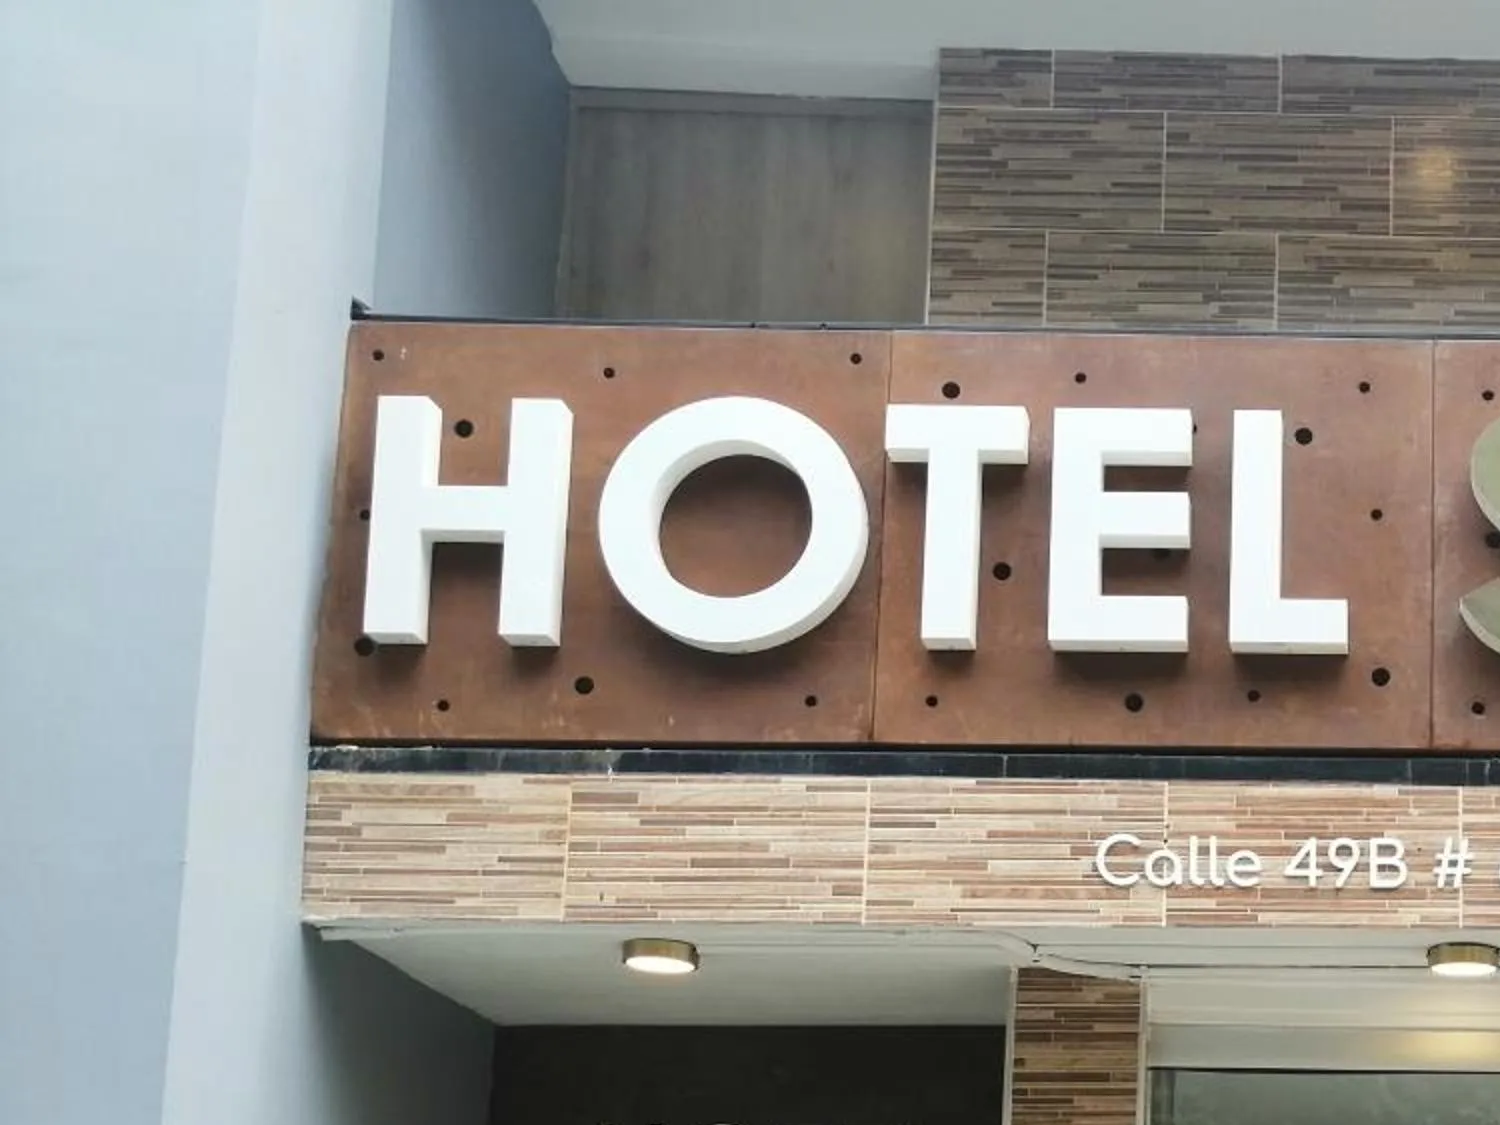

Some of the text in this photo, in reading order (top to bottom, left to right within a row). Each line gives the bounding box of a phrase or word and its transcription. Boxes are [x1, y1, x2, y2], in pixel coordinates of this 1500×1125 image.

[363, 395, 1349, 655] HOTEL
[1095, 832, 1262, 888] Calle
[1283, 836, 1409, 890] 49B
[1432, 837, 1475, 889] #
